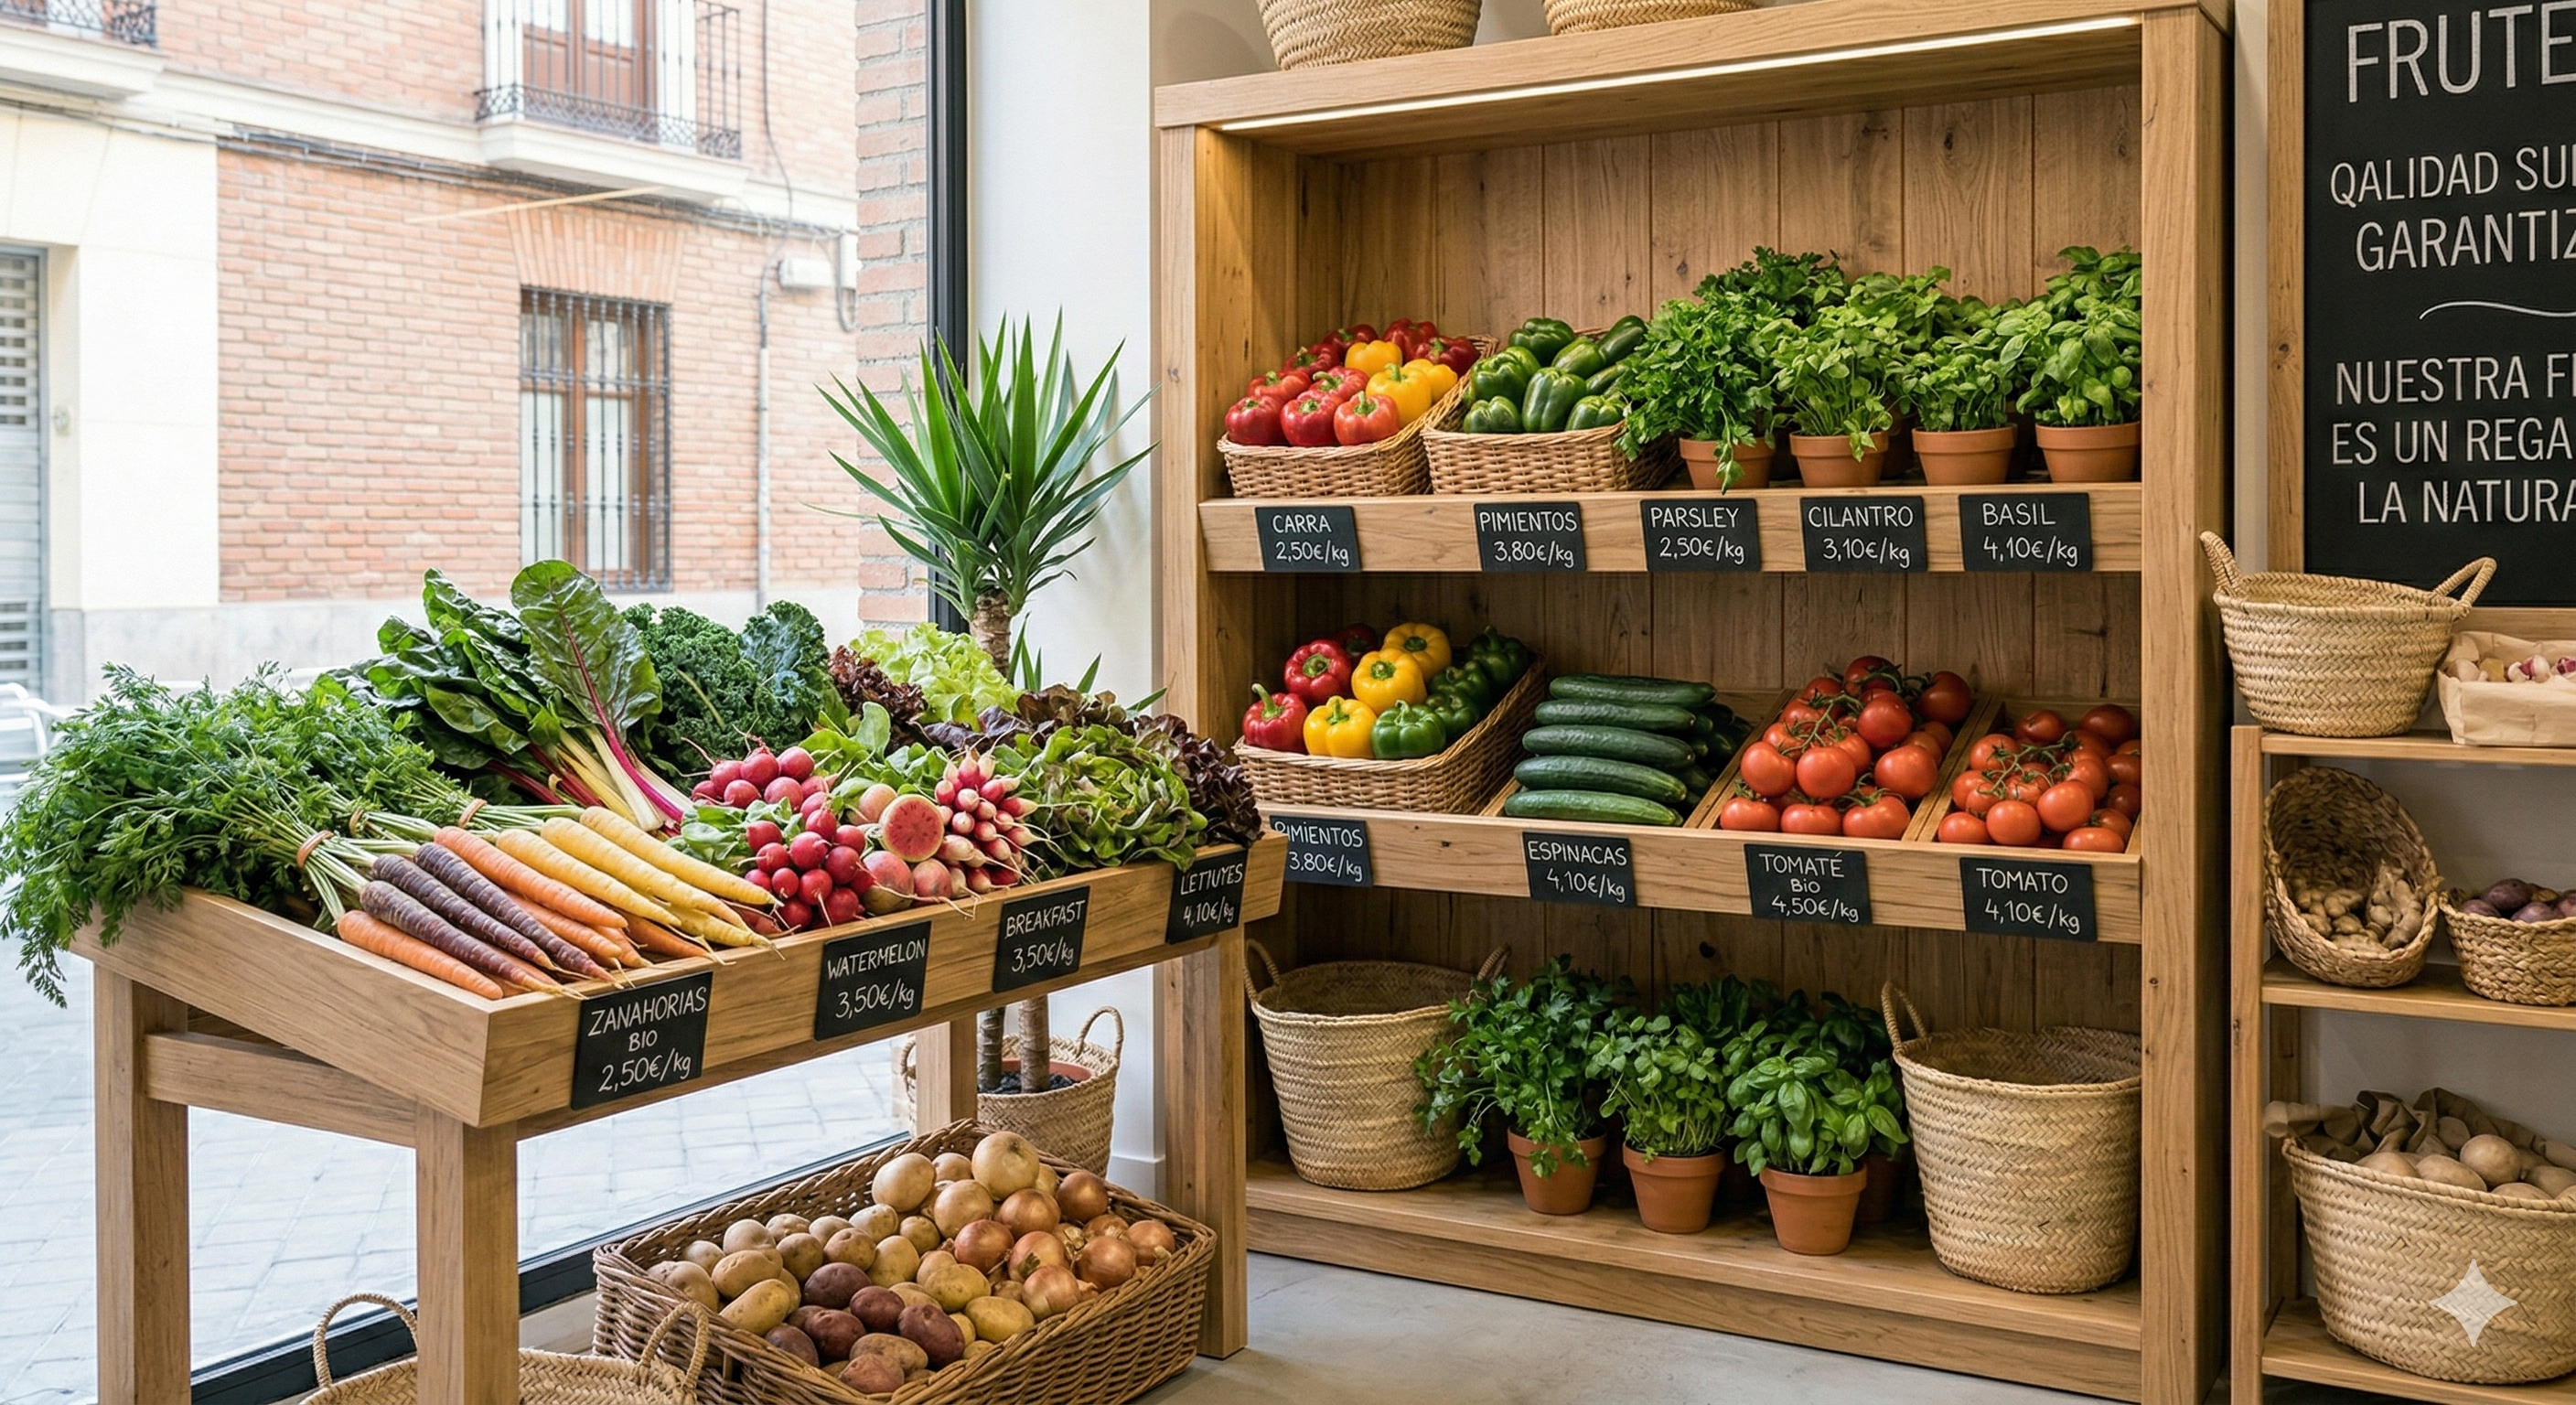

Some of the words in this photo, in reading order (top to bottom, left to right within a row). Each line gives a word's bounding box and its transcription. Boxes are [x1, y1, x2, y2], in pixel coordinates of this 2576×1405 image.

[2348, 0, 2576, 102] FRUTE
[2331, 152, 2498, 208] QALIDAD
[2516, 145, 2576, 190] SU
[2337, 356, 2528, 404] NUESTRA
[2548, 353, 2576, 397] F
[2334, 422, 2377, 464] ES
[2396, 421, 2447, 463] UN
[2467, 417, 2572, 461] REGA
[1809, 506, 1913, 527] CILANTRO
[1983, 503, 2055, 525] BASIL
[2360, 482, 2407, 522] LA
[1273, 514, 1331, 533] CARRA
[1480, 511, 1577, 531] PIMIENTOS
[1651, 508, 1738, 528] PARSLEY
[1276, 540, 1348, 567] 2,50€/kg
[1660, 536, 1744, 564] 2,50€/kg
[1824, 537, 1909, 568] 3,10€/kg
[1984, 536, 2077, 567] 4,10€/kg
[1528, 841, 1626, 865] ESPINACAS
[1759, 852, 1844, 877] TOMATÉ
[1547, 868, 1625, 902] 4,10€/kg
[1976, 868, 2067, 893] TOMATO
[1007, 900, 1085, 937] BREAKFAST
[1772, 896, 1858, 922] 4,50€/kg
[1985, 899, 2079, 934] 4,10€/kg
[828, 939, 925, 978] WATERMELON
[1012, 938, 1073, 972] 3,50€/kg
[587, 986, 706, 1036] ZANAHORIAS
[836, 979, 914, 1018] 3,50€/kg
[629, 1030, 657, 1051] BIO
[598, 1046, 691, 1091] 2,50€/kg
